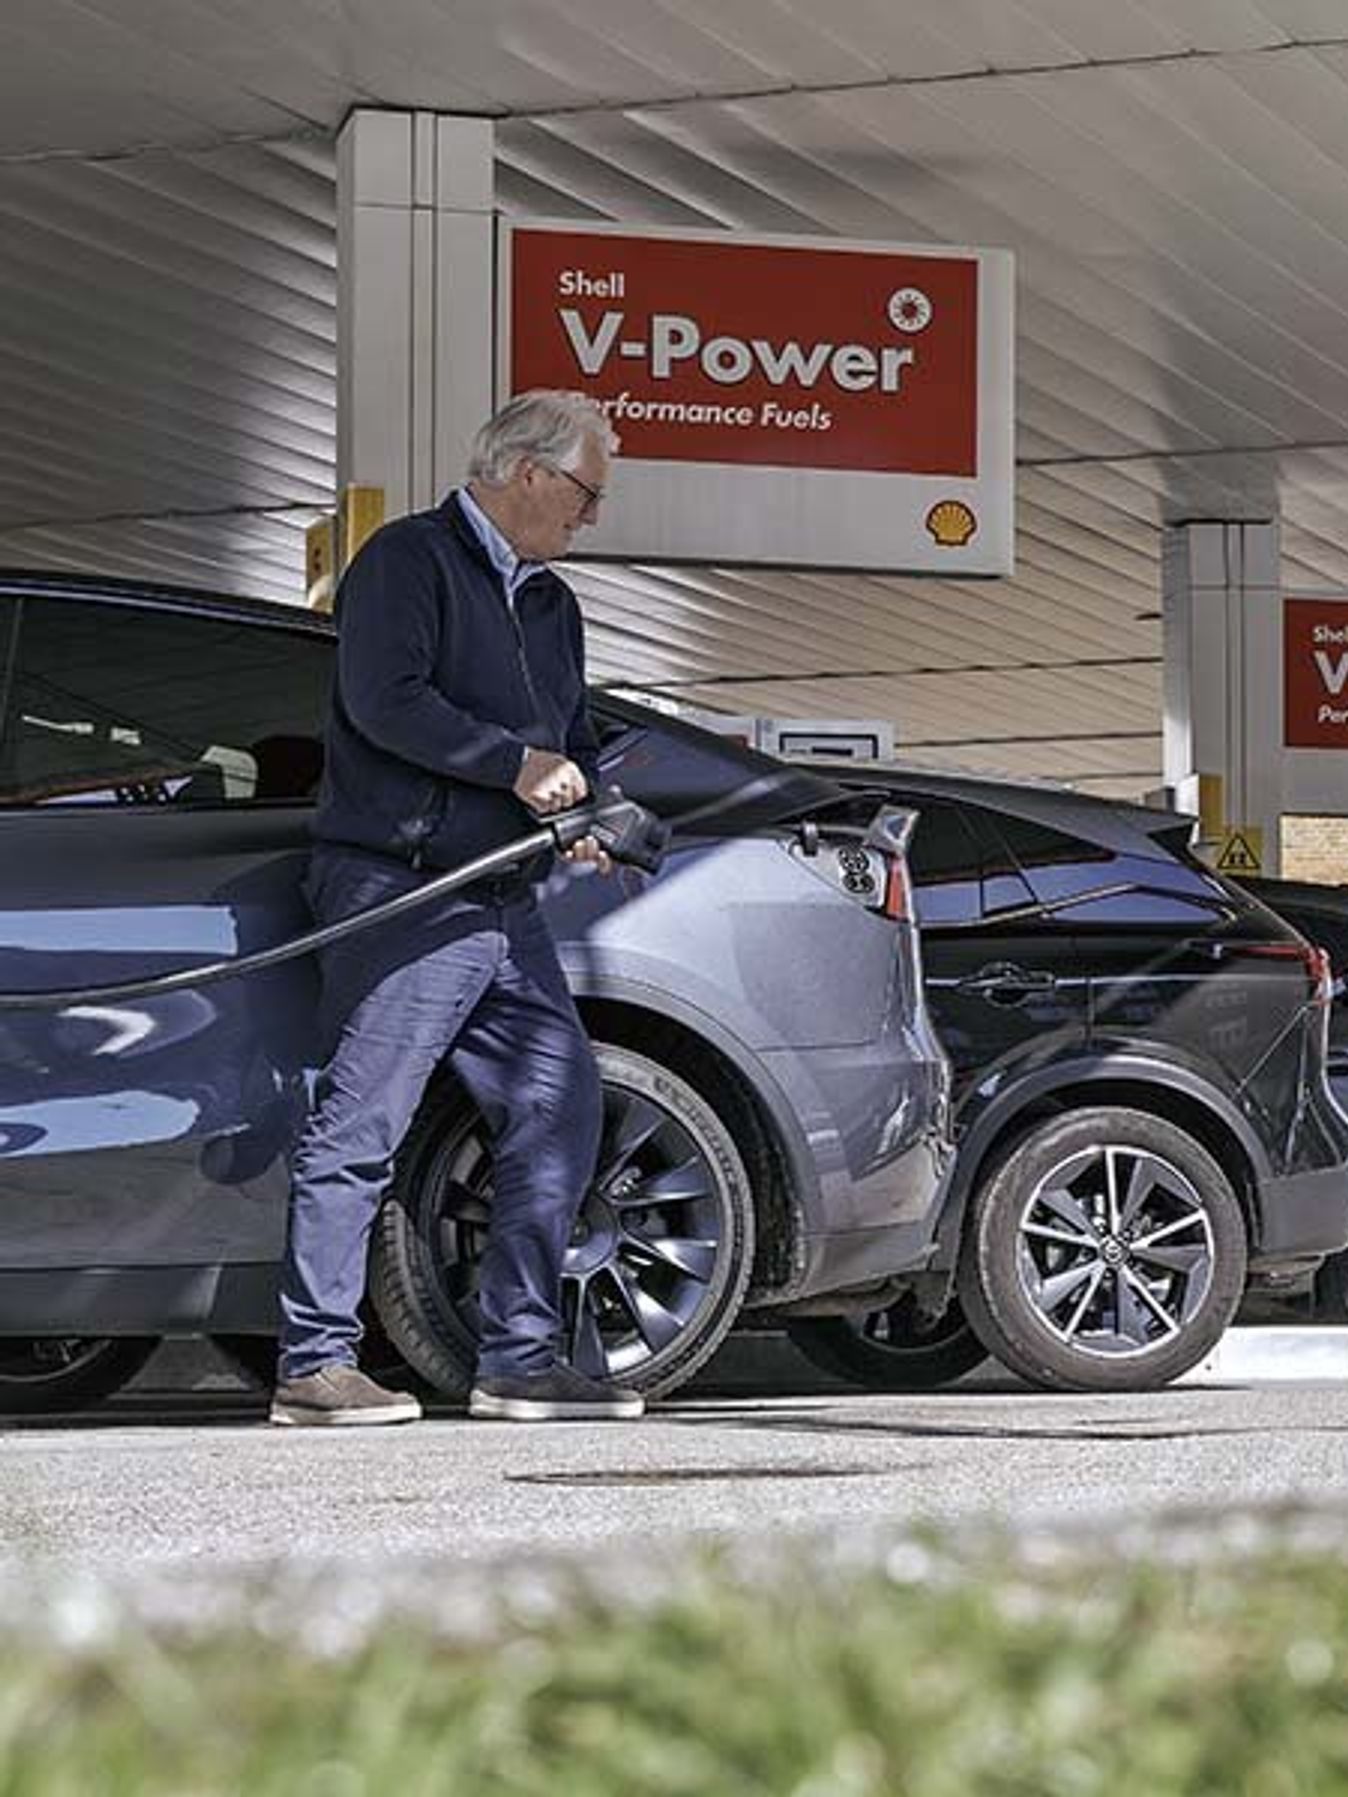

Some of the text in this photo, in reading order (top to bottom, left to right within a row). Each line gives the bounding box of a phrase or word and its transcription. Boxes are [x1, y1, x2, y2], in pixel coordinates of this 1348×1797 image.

[558, 272, 625, 298] Shell
[559, 309, 913, 392] V-Power
[596, 392, 832, 431] rformance Fuels
